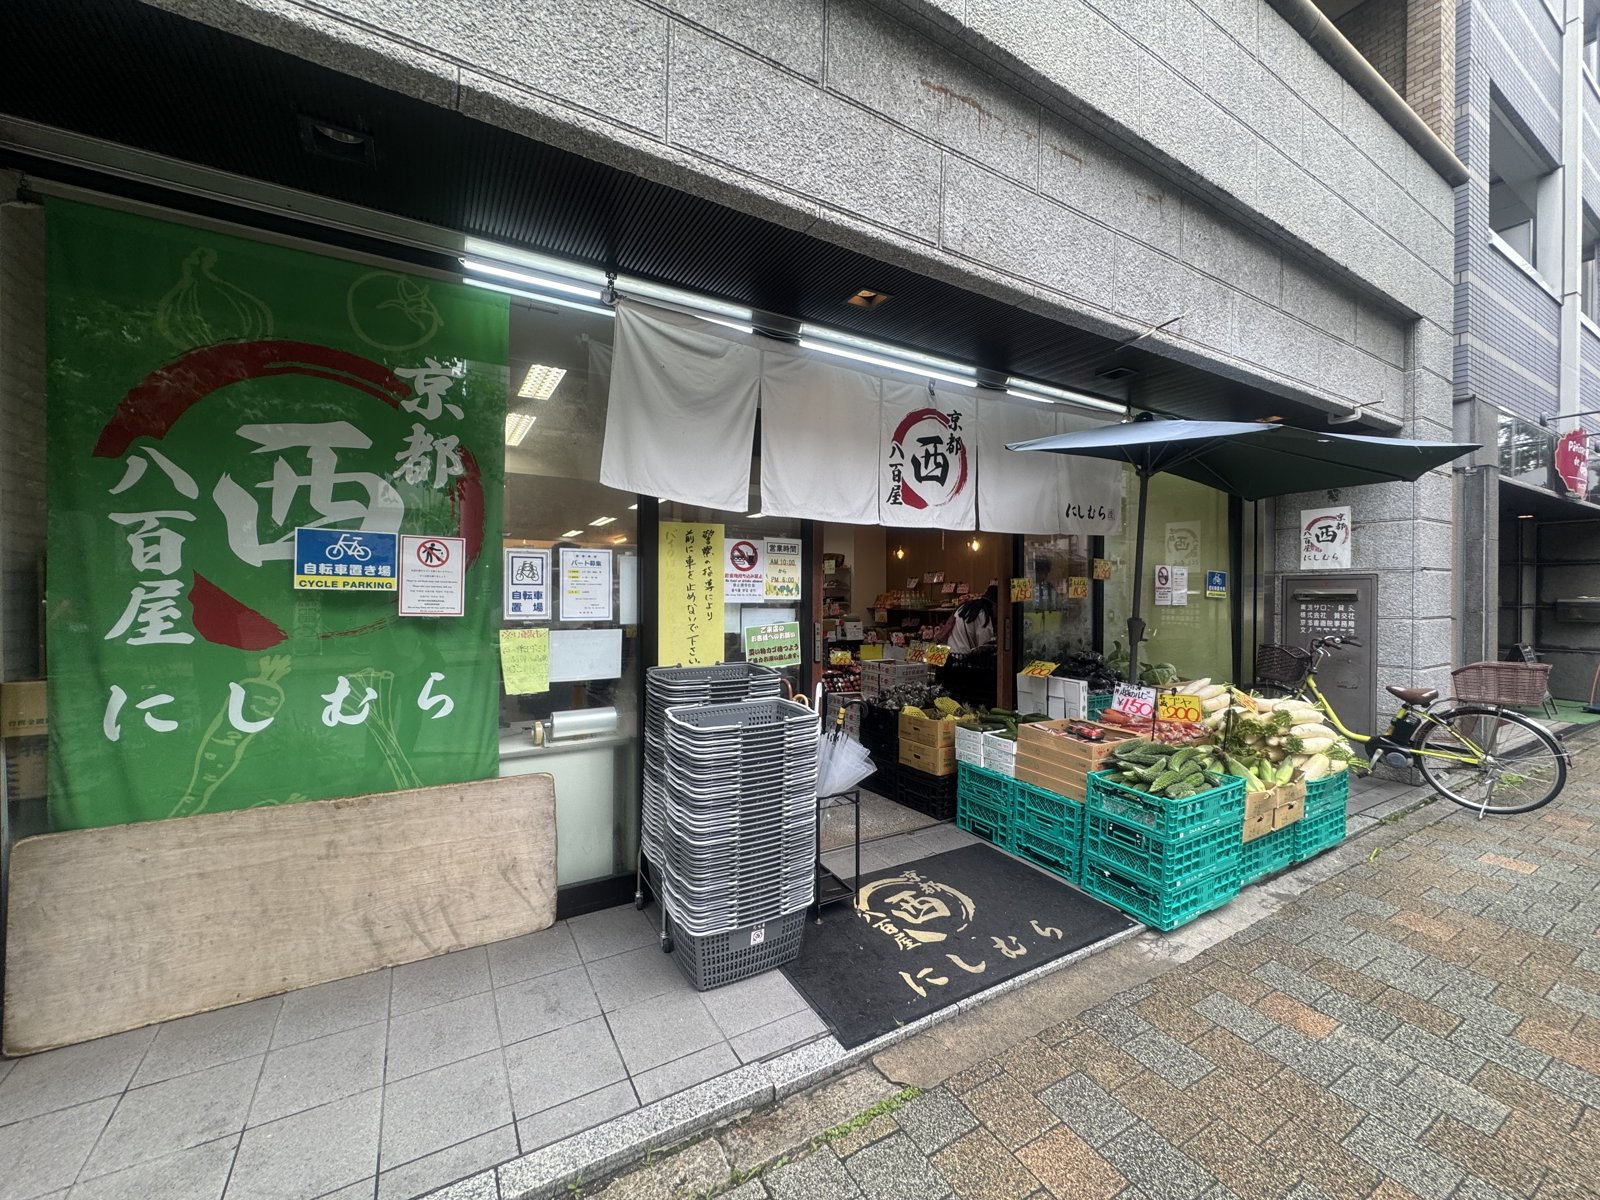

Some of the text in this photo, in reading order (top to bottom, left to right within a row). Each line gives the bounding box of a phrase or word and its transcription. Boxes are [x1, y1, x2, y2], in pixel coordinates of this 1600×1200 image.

[394, 357, 466, 490] 京都
[946, 409, 962, 456] 京都
[886, 443, 905, 506] 八百屋
[911, 435, 950, 487] 西
[1065, 503, 1106, 520] にしむら
[104, 446, 199, 646] 八百屋
[769, 544, 797, 553] 営業時間
[1315, 525, 1338, 543] 西
[303, 563, 391, 577] 自転車置き場
[1303, 553, 1339, 561] にしむら
[299, 579, 393, 590] CYCLE PARKING
[511, 590, 543, 600] 自転車
[103, 671, 456, 742] にしむら
[899, 919, 1063, 998] にしむら
